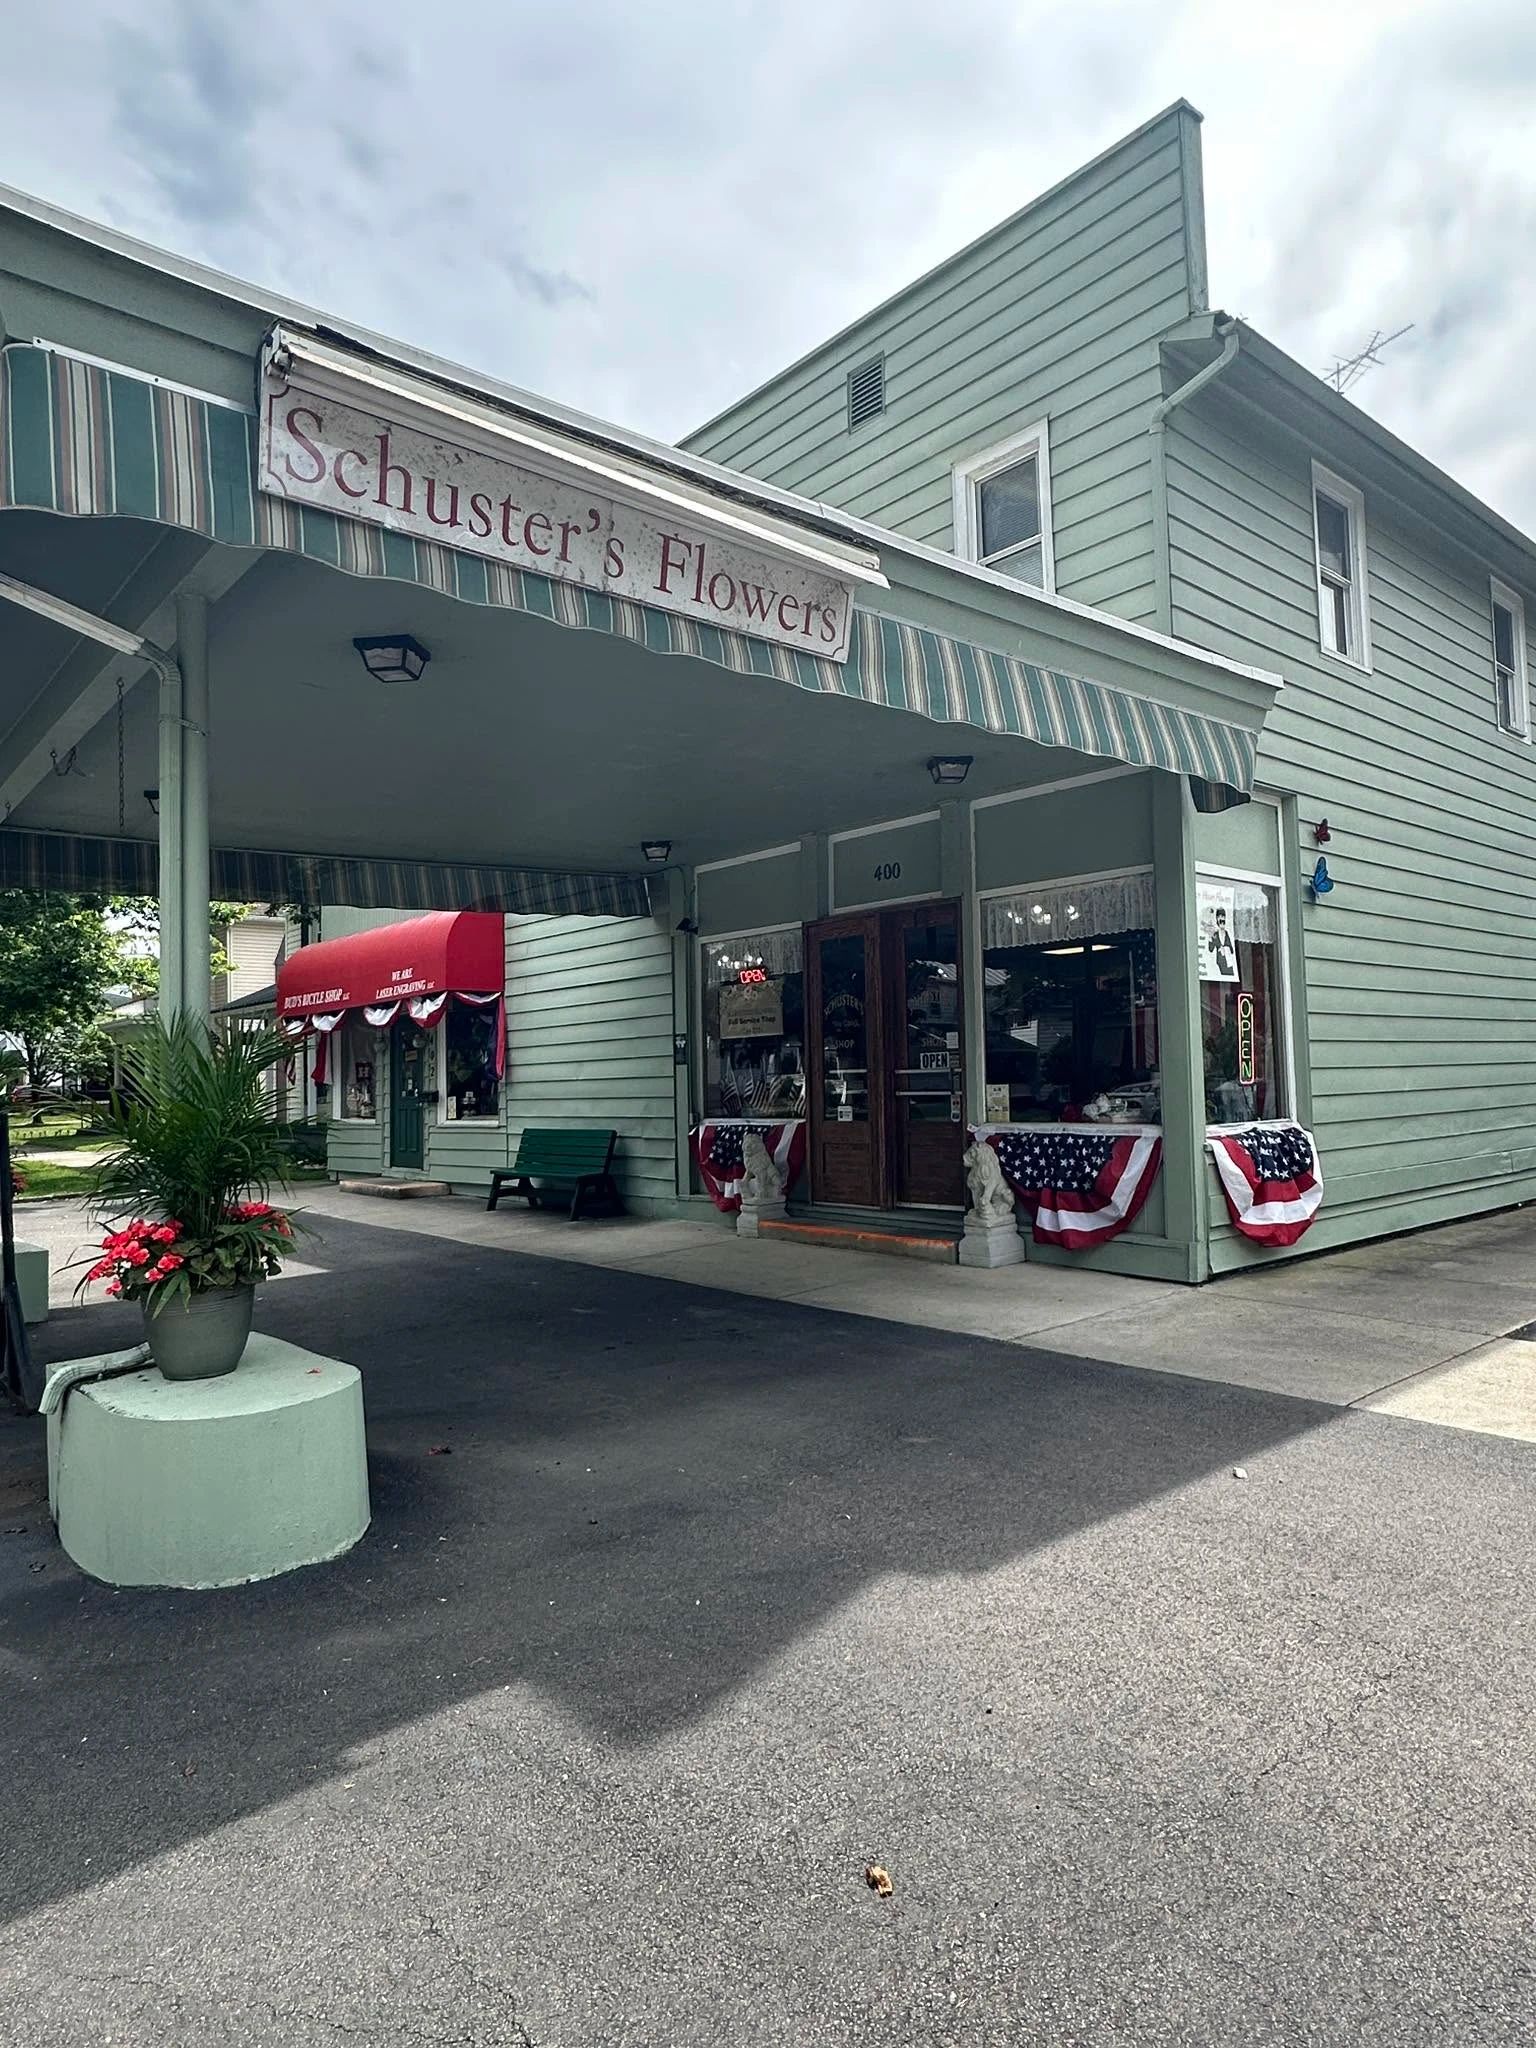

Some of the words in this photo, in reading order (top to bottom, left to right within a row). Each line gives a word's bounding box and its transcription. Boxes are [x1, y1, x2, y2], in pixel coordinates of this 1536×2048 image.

[284, 406, 625, 579] Schuster's
[653, 531, 839, 643] Flowers
[874, 862, 901, 881] 400
[392, 970, 401, 982] WE
[401, 968, 413, 979] ARE
[740, 968, 766, 984] OPEN
[284, 995, 302, 1009] BUD'S
[324, 988, 343, 1003] SHOP
[375, 987, 393, 1000] LASER
[393, 979, 426, 996] ENGRAVING
[833, 1039, 856, 1049] SHOP
[1240, 998, 1252, 1078] OPEN
[922, 1052, 948, 1068] OPEN
